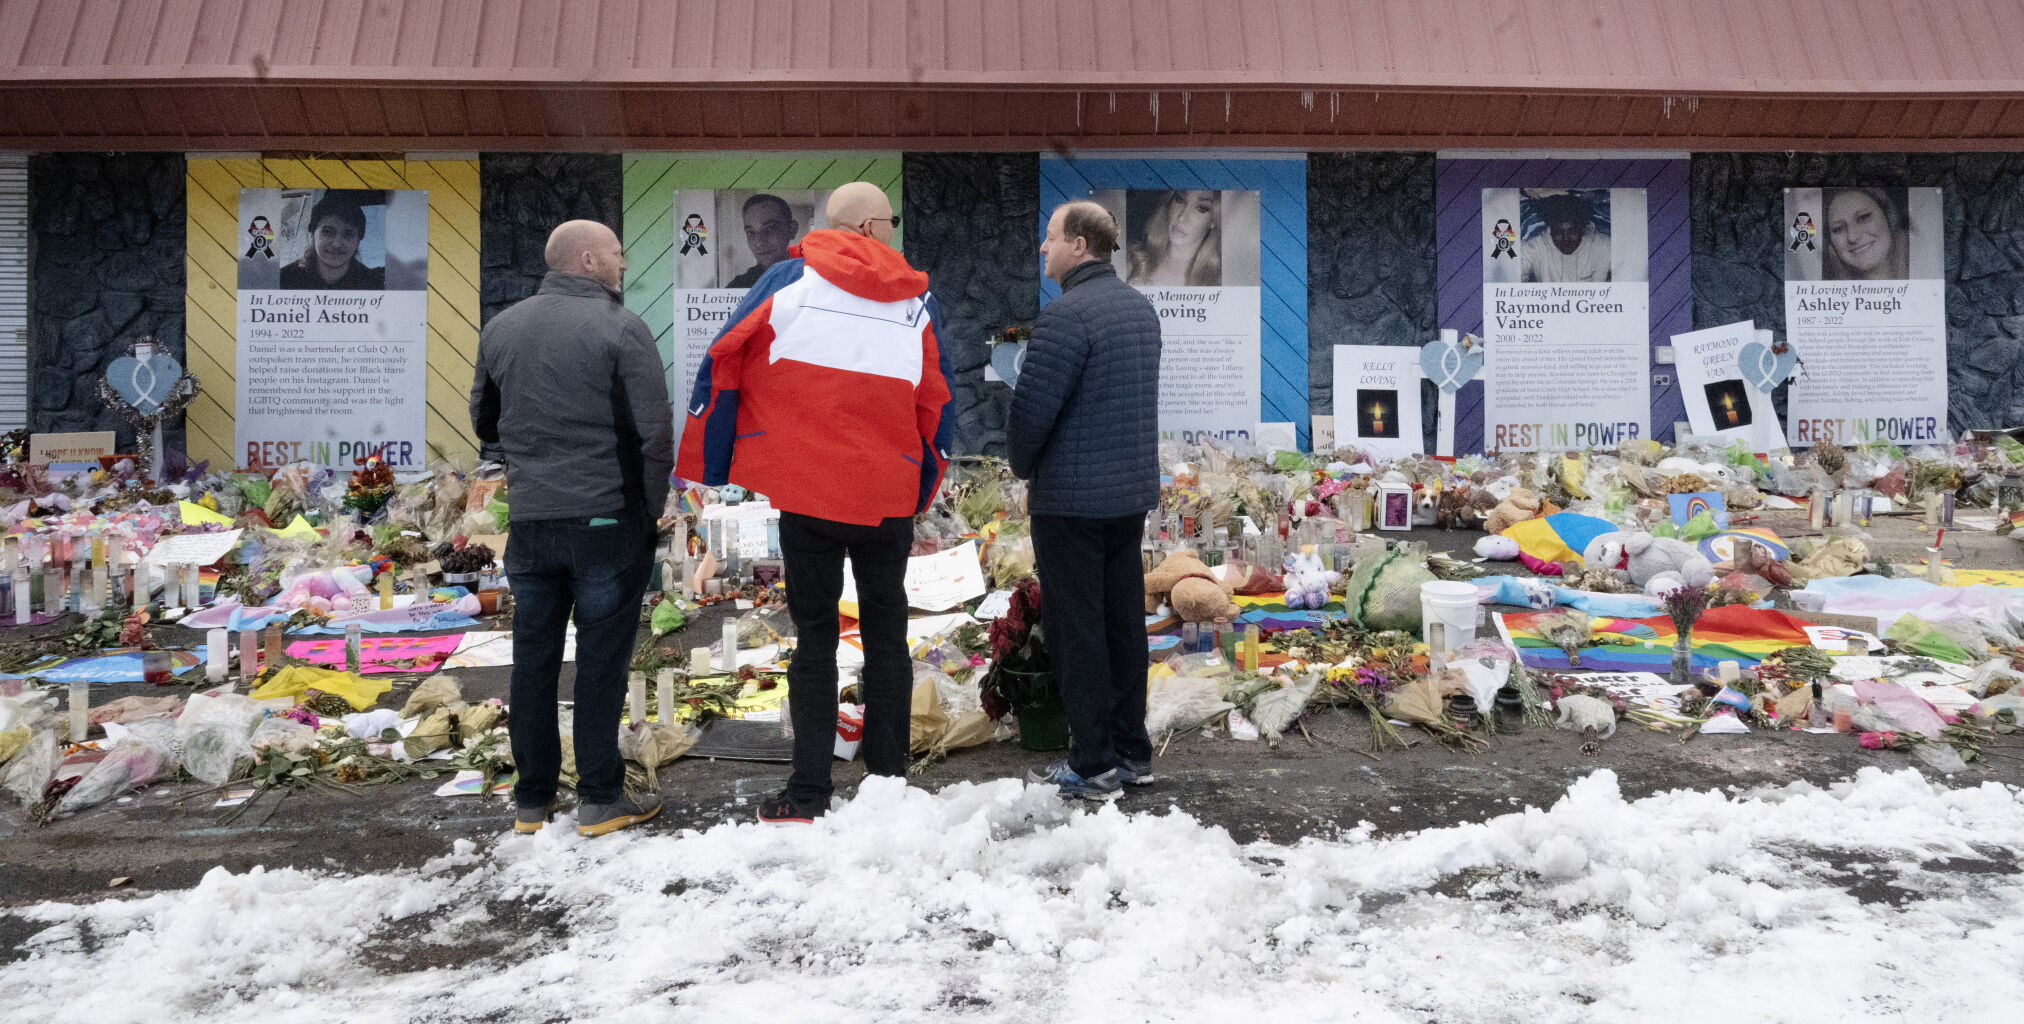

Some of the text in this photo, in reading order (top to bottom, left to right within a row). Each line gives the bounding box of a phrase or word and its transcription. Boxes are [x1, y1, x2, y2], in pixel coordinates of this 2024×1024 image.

[1158, 291, 1205, 303] Memory
[1209, 290, 1221, 303] of
[1495, 287, 1612, 299] In Loving Memory of
[1796, 284, 1909, 297] In Loving Memory of
[250, 295, 384, 308] In Loving Memory of
[686, 294, 744, 306] In Loving
[1798, 298, 1901, 314] Ashley Paugh
[687, 307, 731, 321] Derri
[1496, 300, 1623, 317] Raymond Green
[251, 308, 369, 323] Daniel Aston
[1798, 317, 1815, 325] 1987
[1496, 317, 1544, 329] Vance
[250, 329, 272, 338] 1994
[281, 329, 304, 338] 2022
[687, 327, 707, 336] 1984
[1495, 334, 1516, 343] 2000
[1523, 334, 1544, 343] 2022
[249, 345, 277, 353] Daniel
[304, 345, 346, 353] bartender
[347, 345, 355, 353] at
[357, 345, 378, 353] Club
[392, 345, 405, 353] An
[1693, 337, 1739, 354] RAYMOND
[249, 355, 407, 366] outspoken trans man, he continuously
[1703, 351, 1735, 367] GREEN
[249, 365, 405, 376] helped raise donations for Black trans
[1362, 362, 1396, 371] KELLY
[249, 375, 277, 386] people
[292, 375, 304, 384] his
[353, 375, 381, 384] Daniel
[383, 375, 390, 384] is
[1359, 376, 1397, 387] LOVING
[249, 385, 391, 396] remembered for his support in the
[249, 396, 281, 407] LGBTQ
[282, 396, 330, 407] community
[332, 396, 349, 404] and
[369, 396, 382, 404] the
[384, 396, 404, 407] light
[248, 406, 265, 415] that
[267, 406, 313, 417] brightened
[315, 406, 328, 415] the
[1495, 422, 1640, 448] REST IN POWER
[1798, 418, 1845, 442] REST
[1876, 417, 1936, 440] POWER
[248, 441, 413, 466] REST IN POWER
